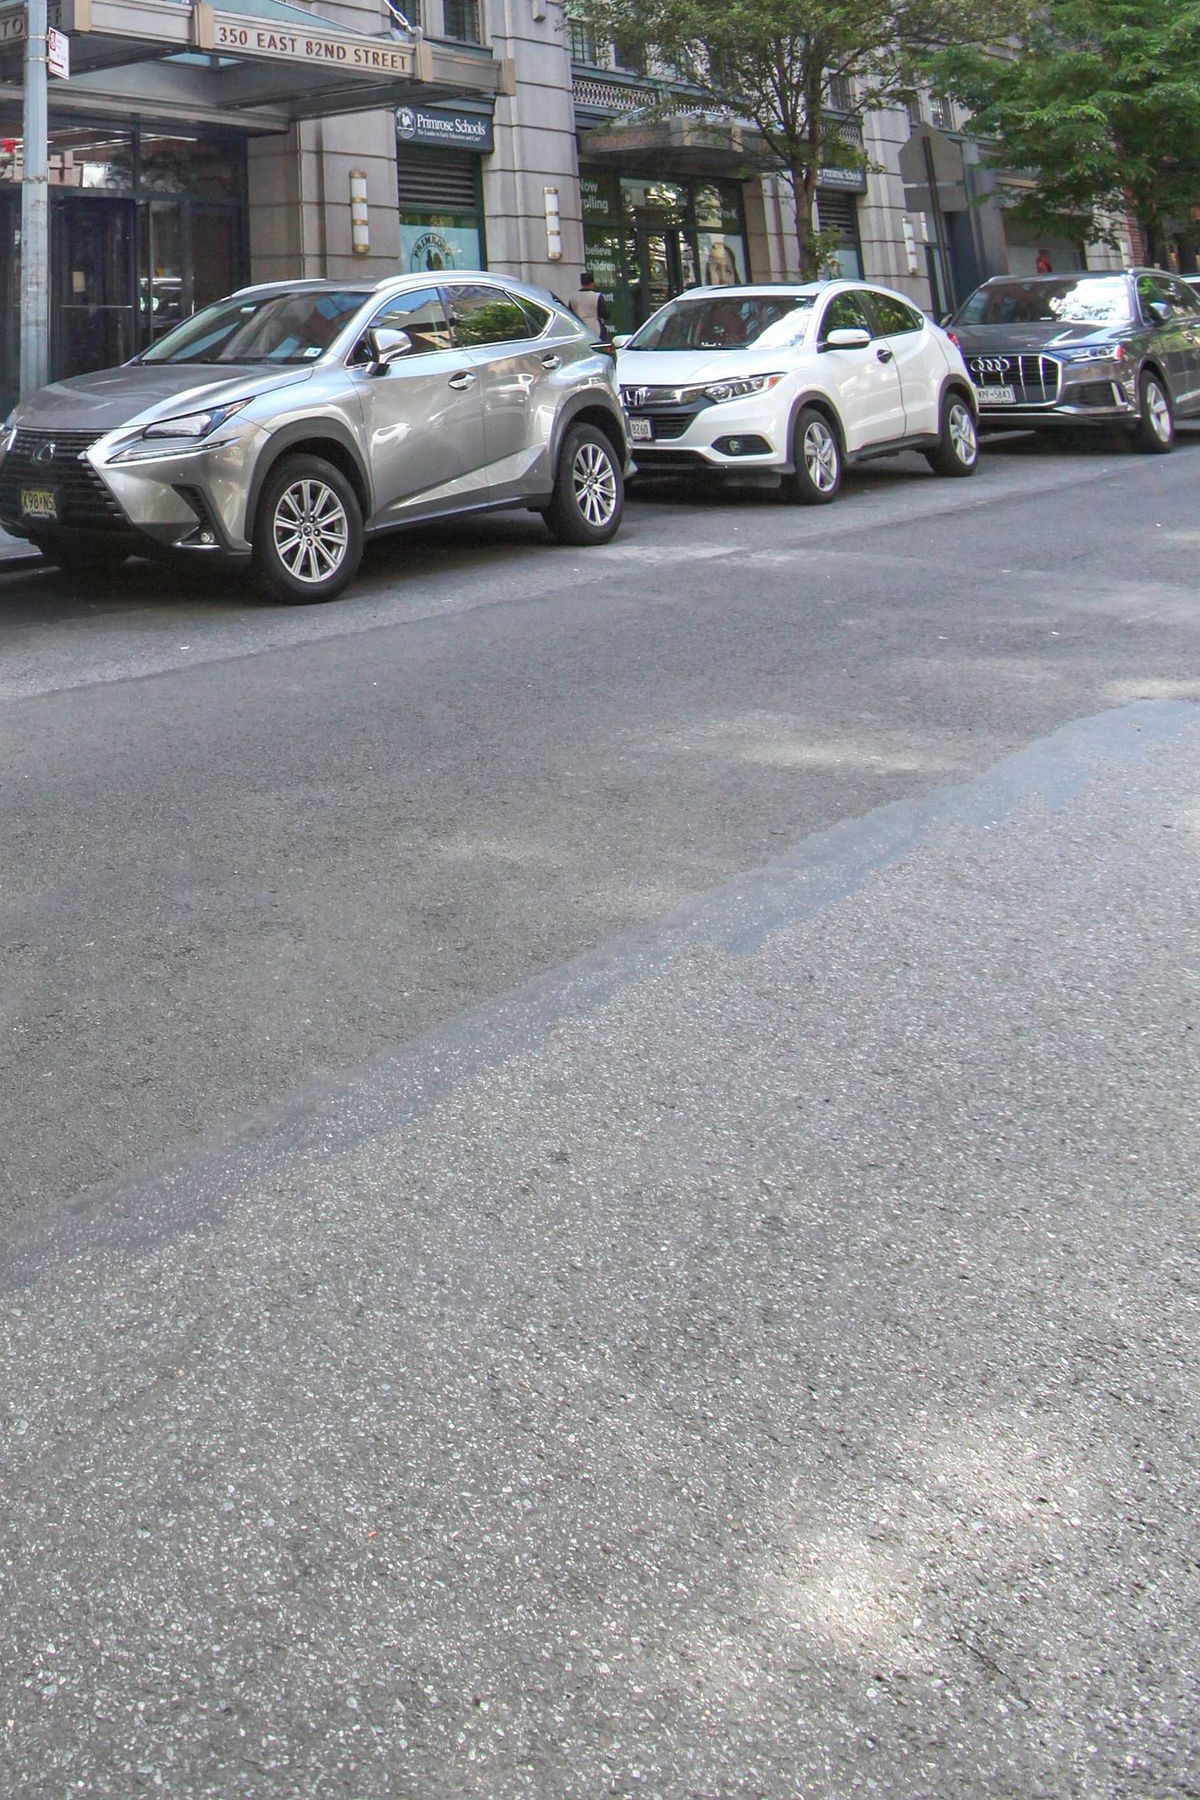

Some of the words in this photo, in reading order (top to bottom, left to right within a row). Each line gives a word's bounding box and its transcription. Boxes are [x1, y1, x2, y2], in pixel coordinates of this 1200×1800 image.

[218, 26, 248, 46] 350
[257, 32, 298, 53] EAST
[305, 40, 346, 60] 82ND
[354, 49, 408, 70] STREET
[416, 113, 454, 132] Primrose
[454, 118, 486, 136] Schools
[587, 260, 616, 272] children
